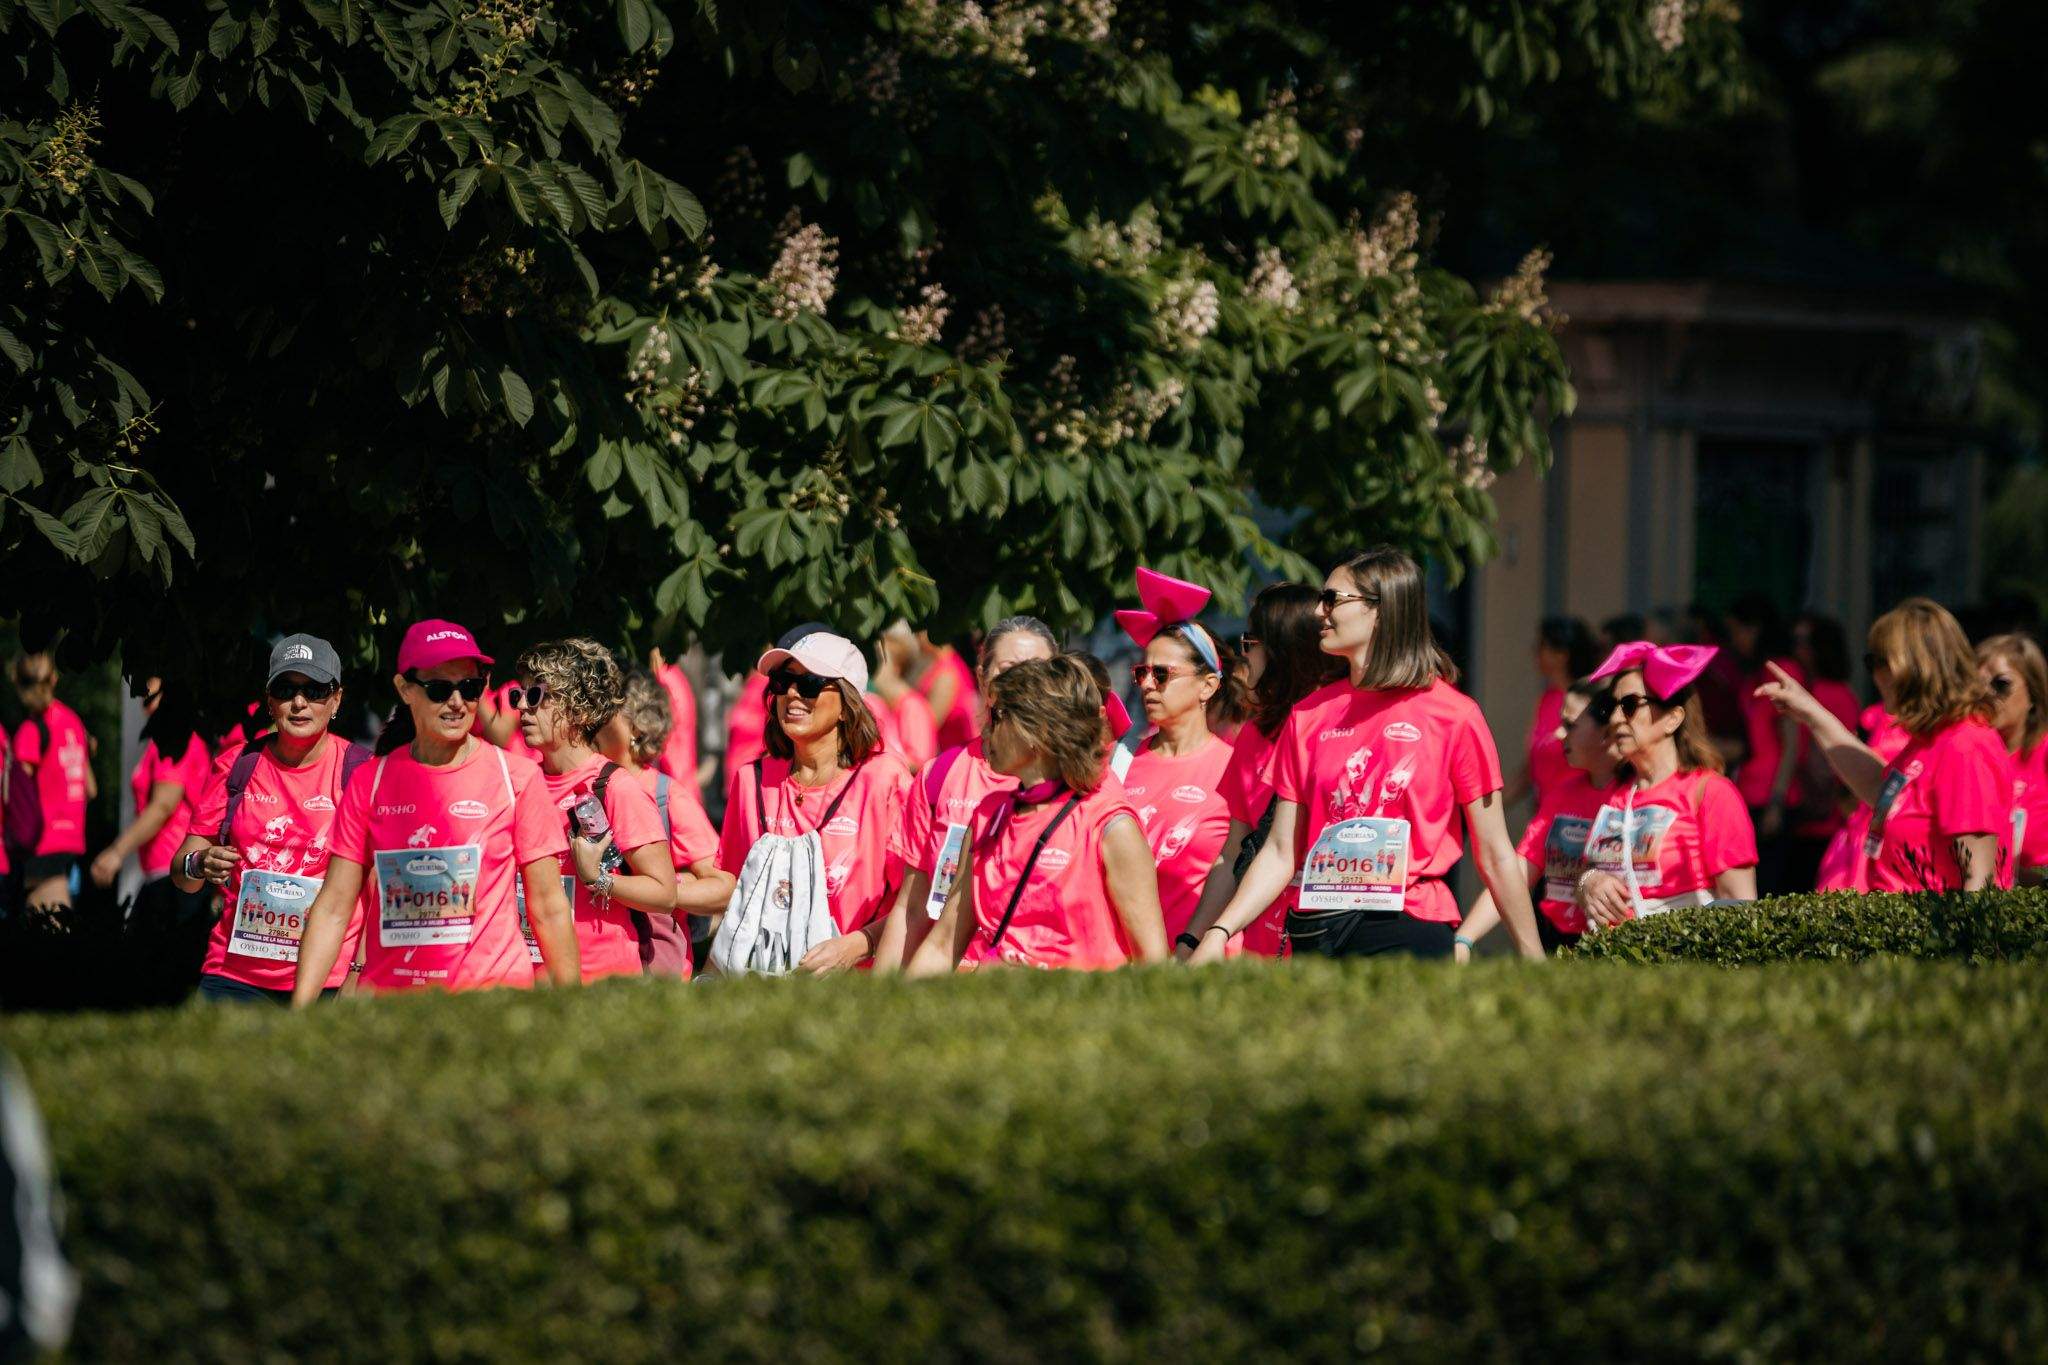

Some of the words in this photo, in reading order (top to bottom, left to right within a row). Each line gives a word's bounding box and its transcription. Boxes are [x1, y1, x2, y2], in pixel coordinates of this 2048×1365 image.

[1336, 857, 1373, 873] 016
[268, 885, 304, 897] ASTURIANA
[413, 891, 449, 907] 016
[1311, 896, 1344, 904] OYSHO
[264, 911, 300, 929] 016
[240, 943, 269, 953] OYSHO
